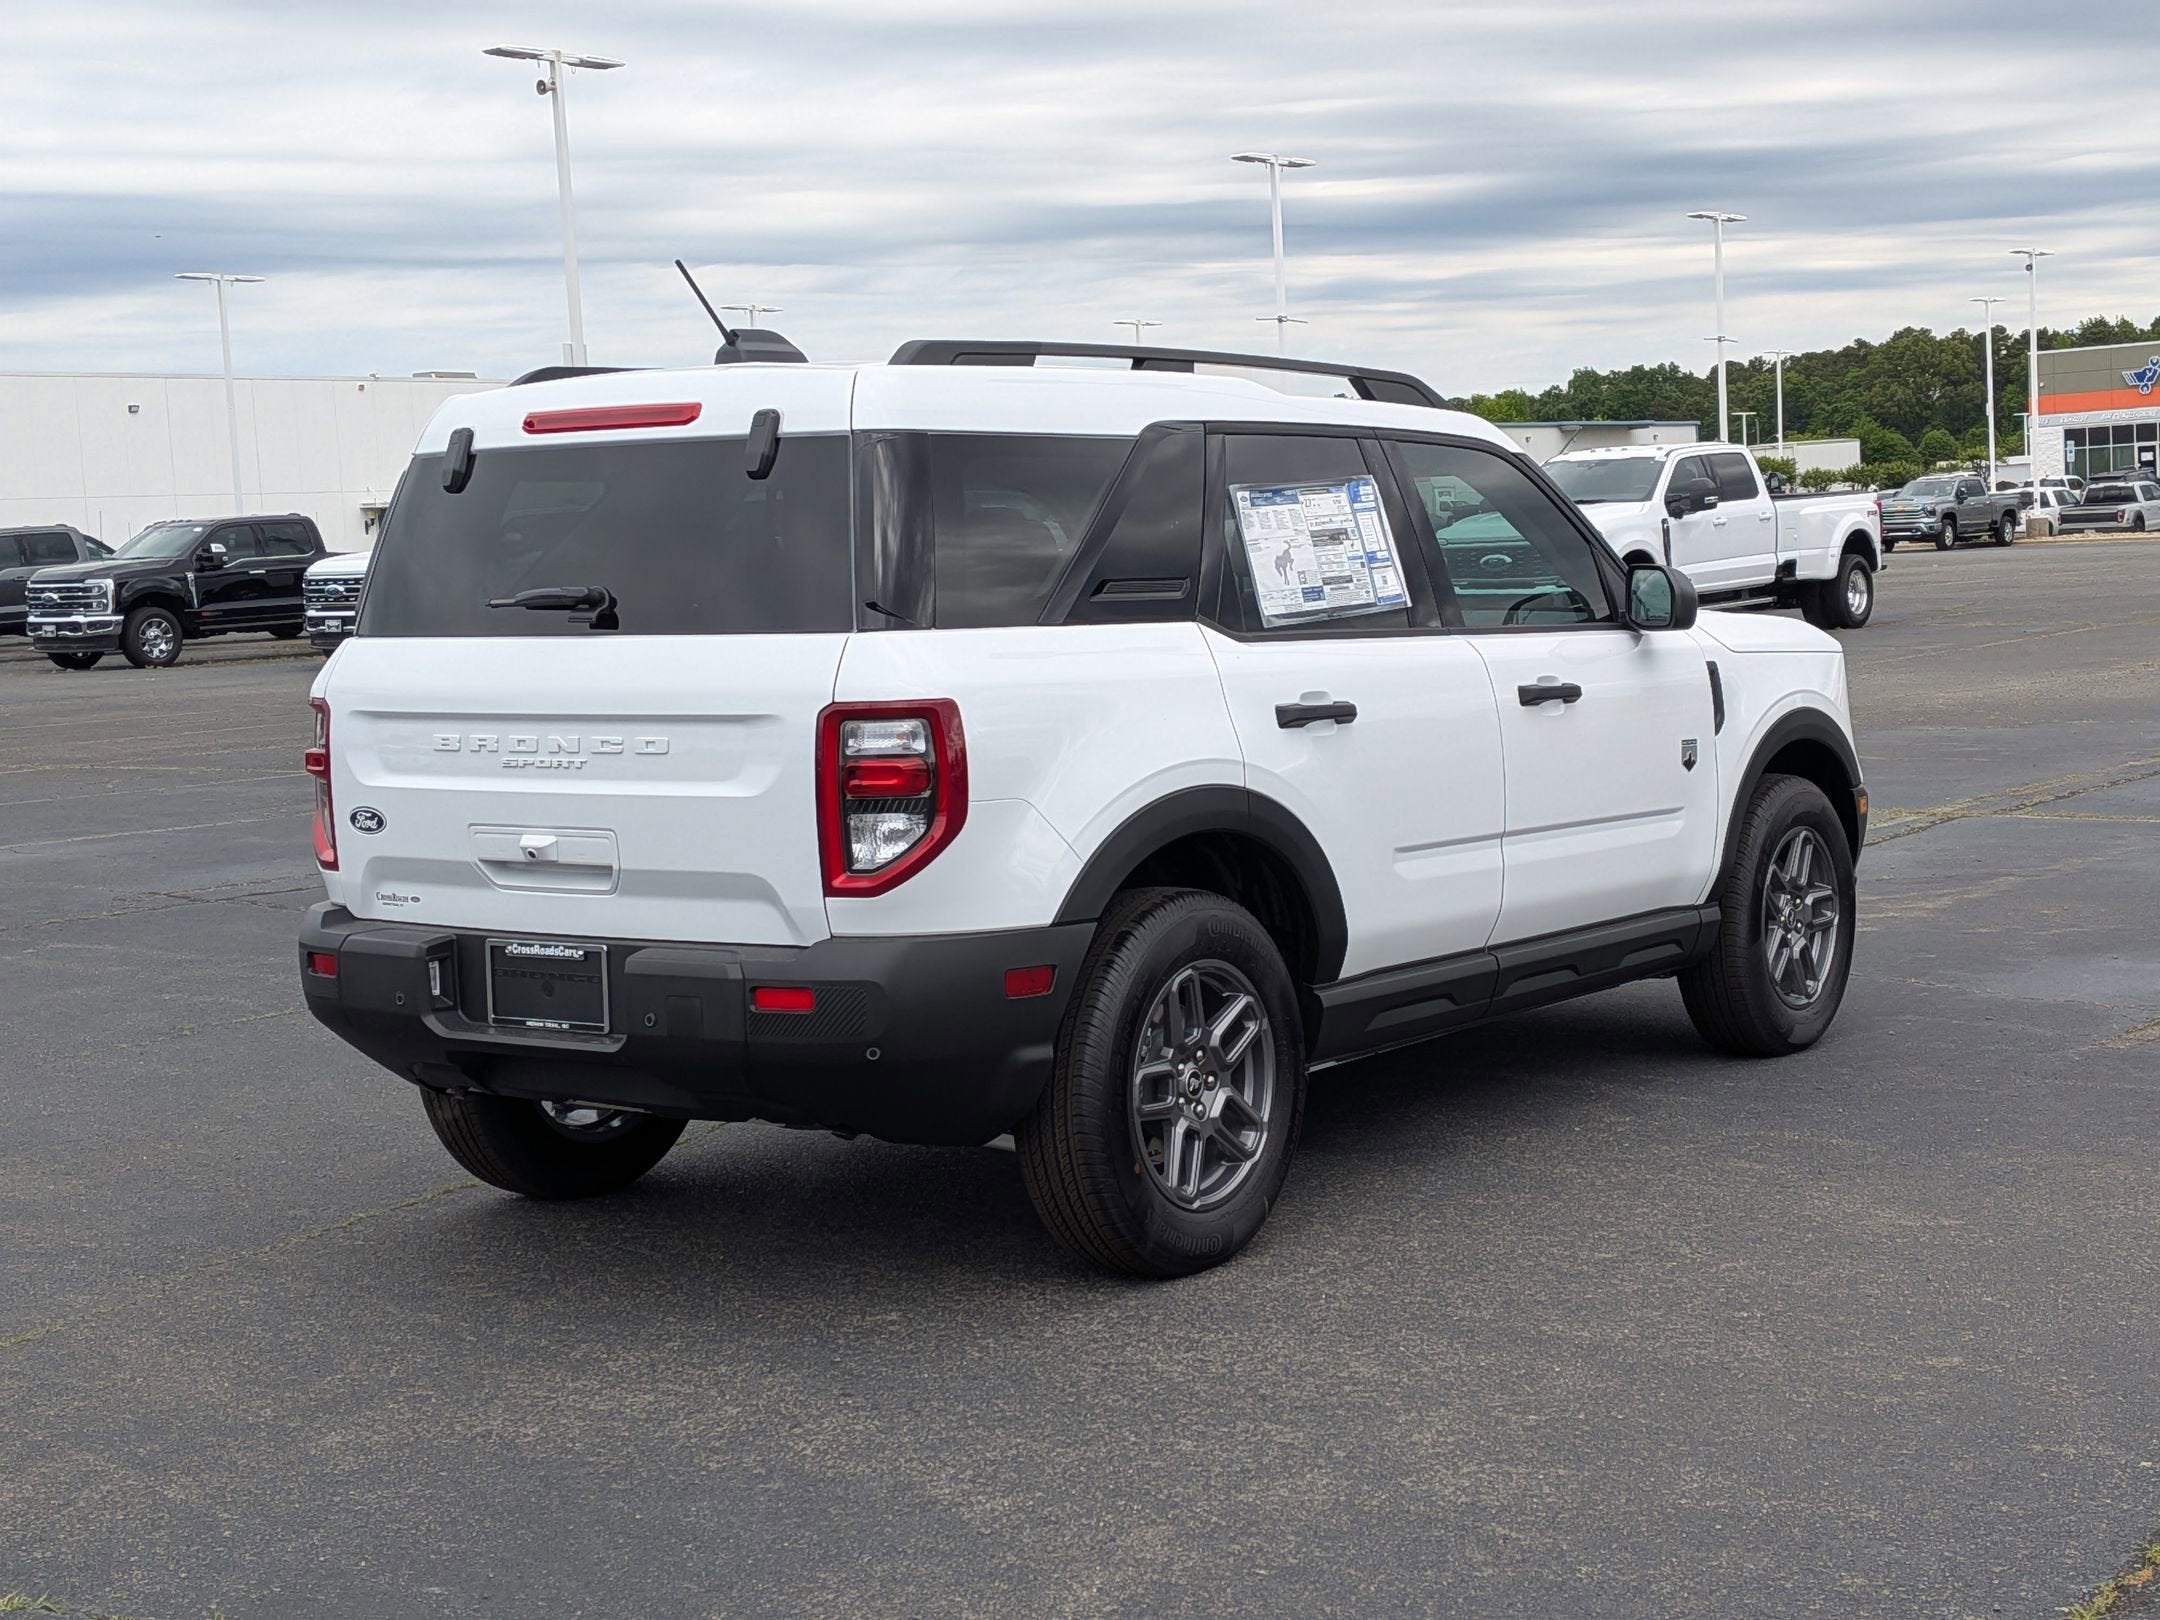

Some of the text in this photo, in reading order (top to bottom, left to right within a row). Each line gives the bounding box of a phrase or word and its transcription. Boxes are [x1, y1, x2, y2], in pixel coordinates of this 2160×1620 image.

[433, 734, 670, 754] BRONCO
[501, 757, 588, 769] SPORT
[354, 811, 378, 829] Ford
